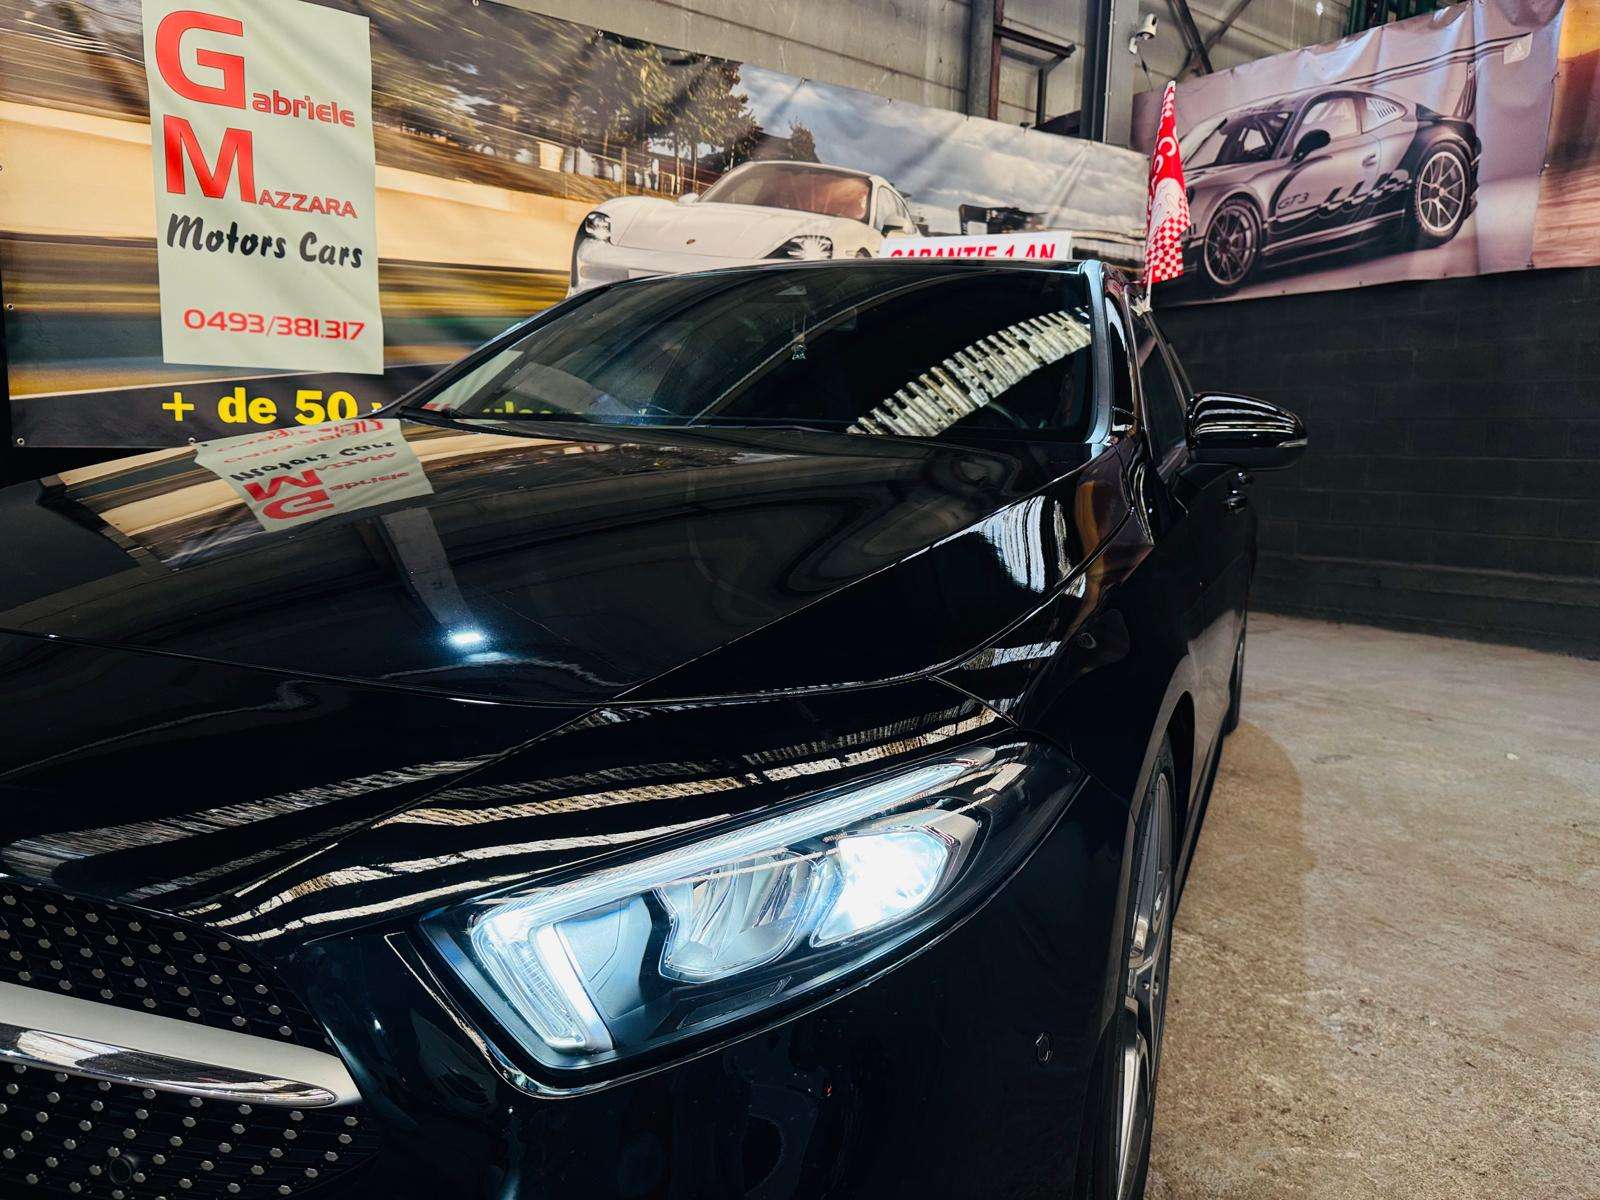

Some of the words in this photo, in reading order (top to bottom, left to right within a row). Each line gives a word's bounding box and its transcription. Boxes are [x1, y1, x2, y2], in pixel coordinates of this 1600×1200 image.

[155, 10, 356, 128] Gabriele
[163, 114, 358, 218] MAZZARA
[1277, 192, 1310, 210] GT3
[166, 212, 286, 259] Motors
[299, 231, 363, 269] Cars
[1005, 244, 1015, 257] 1
[1026, 243, 1056, 258] AN
[183, 308, 365, 341] 0493/381.317
[217, 387, 278, 425] de
[294, 389, 359, 426] 50
